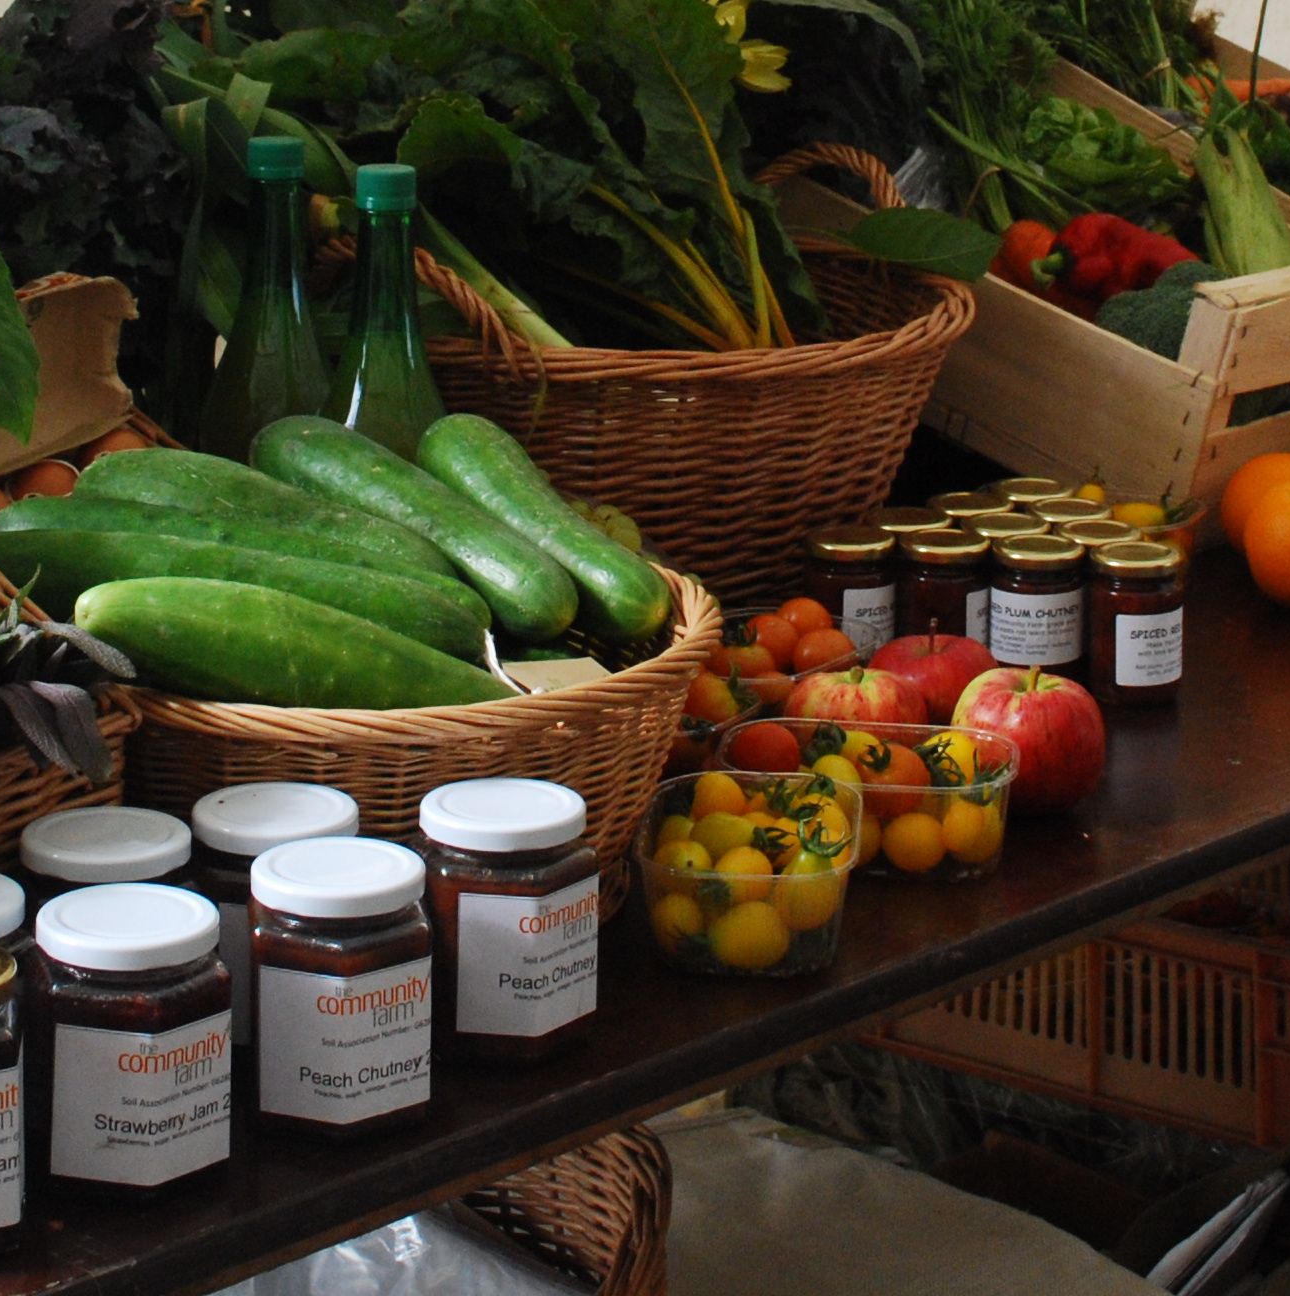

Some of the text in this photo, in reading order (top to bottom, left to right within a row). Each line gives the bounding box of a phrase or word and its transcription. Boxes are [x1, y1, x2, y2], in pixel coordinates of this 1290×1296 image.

[1005, 606, 1031, 618] PLUM
[1130, 628, 1168, 640] SPICED
[562, 914, 593, 941] farm
[498, 972, 549, 991] Peach
[551, 954, 596, 984] Chutney
[316, 976, 429, 1017] community
[372, 1000, 415, 1028] farm
[117, 1031, 228, 1075] community
[139, 1042, 159, 1054] the
[174, 1056, 213, 1086] farm
[299, 1066, 353, 1088] Peach
[358, 1054, 424, 1085] Chutney
[120, 1096, 138, 1106] Soil
[93, 1112, 187, 1136] Strawberry
[189, 1099, 219, 1122] Jam
